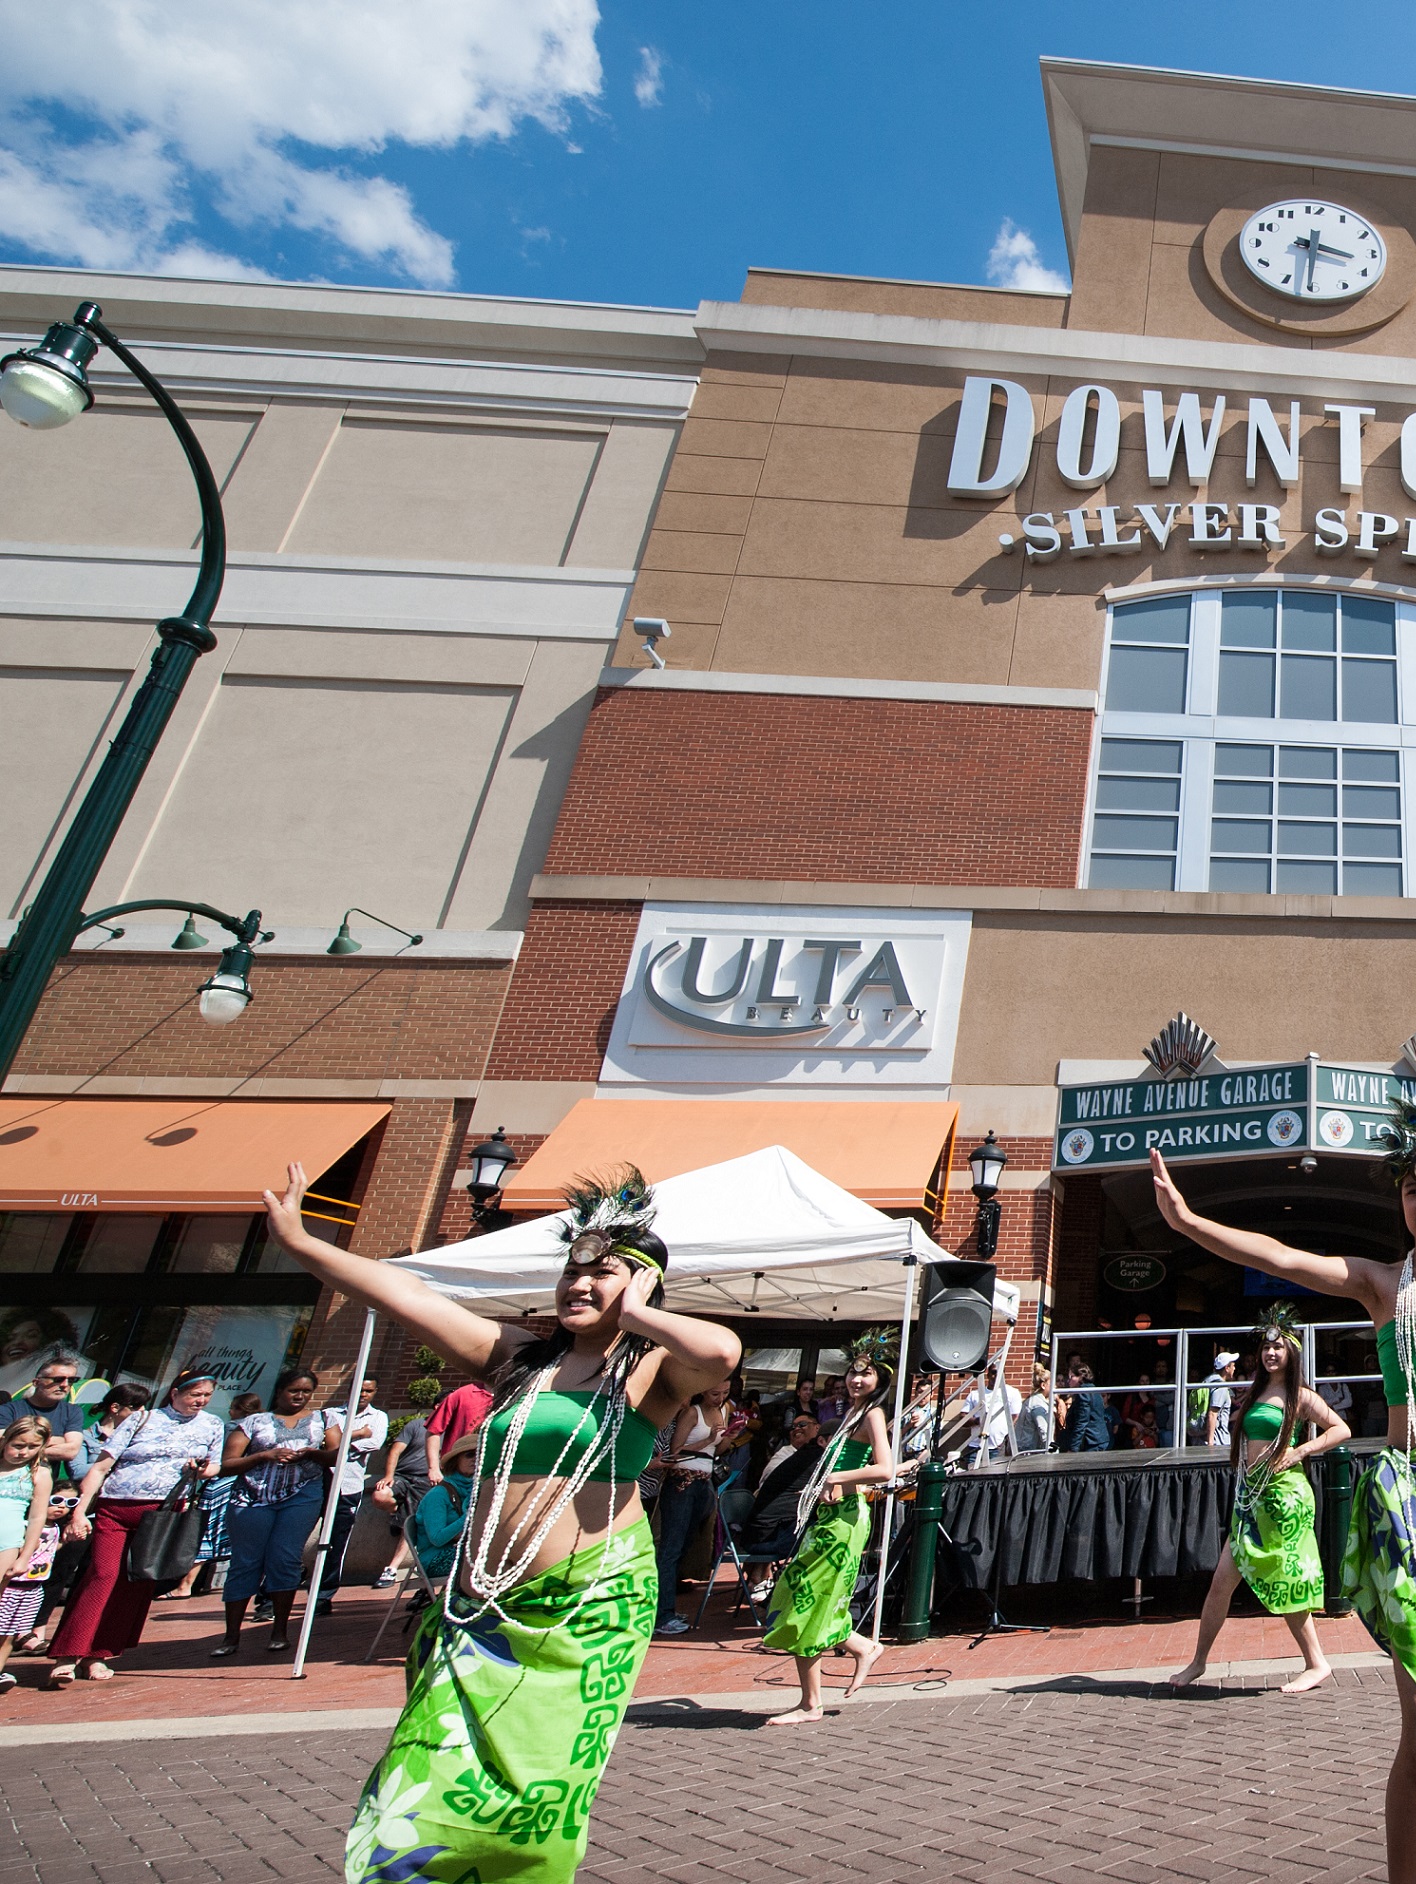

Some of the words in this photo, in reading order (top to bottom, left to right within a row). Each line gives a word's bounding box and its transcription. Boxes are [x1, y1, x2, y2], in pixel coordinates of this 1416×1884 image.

[1277, 209, 1295, 220] 11
[1304, 206, 1325, 217] 12
[1339, 214, 1347, 224] 1
[1258, 222, 1280, 234] 10
[1357, 229, 1370, 241] 2
[1248, 237, 1262, 248] 9
[1365, 249, 1378, 260] 3
[1256, 257, 1270, 268] 8
[1356, 267, 1369, 277] 4
[1279, 273, 1292, 284] 7
[1306, 282, 1321, 293] 6
[1336, 279, 1349, 290] 5
[680, 936, 913, 1009] ULTA
[746, 1005, 928, 1024] BEAUTY
[1331, 1072, 1389, 1105] WAYNE
[1076, 1087, 1133, 1119] WAYNE
[1143, 1080, 1209, 1113] AVENUE
[1220, 1071, 1292, 1105] GARAGE
[1100, 1132, 1136, 1153] TO
[1145, 1120, 1262, 1149] PARKING
[60, 1193, 98, 1206] ULTA
[1120, 1260, 1152, 1269] Parking
[1120, 1269, 1150, 1278] Garage
[197, 1346, 216, 1358] all
[216, 1346, 253, 1362] things
[217, 1384, 243, 1392] PLACE
